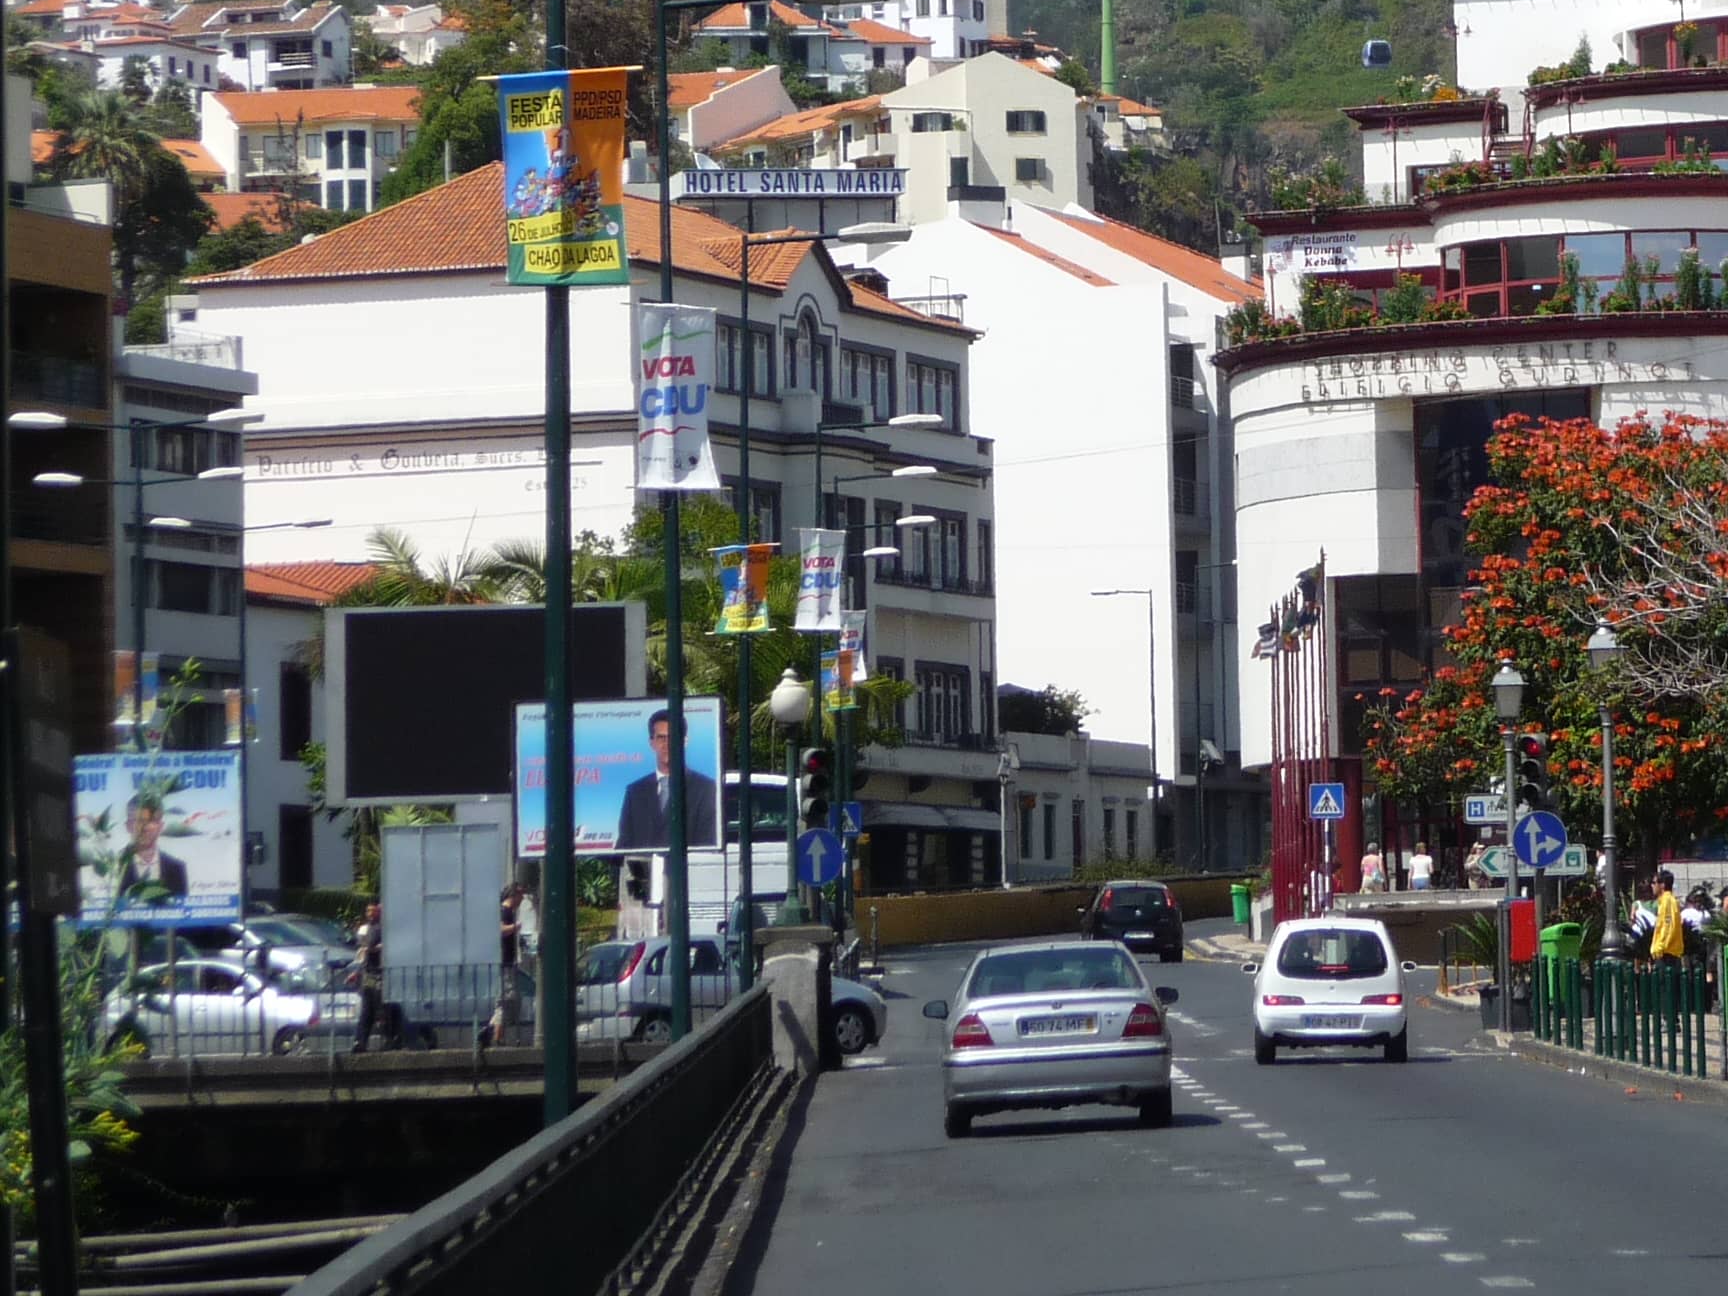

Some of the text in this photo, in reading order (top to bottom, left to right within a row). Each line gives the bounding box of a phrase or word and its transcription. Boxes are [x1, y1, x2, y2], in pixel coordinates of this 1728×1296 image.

[510, 95, 562, 114] FESTA
[573, 89, 622, 106] PPD/PSD
[511, 110, 563, 129] POPULAR
[573, 104, 621, 121] MADEIRA
[686, 171, 902, 193] HOTEL SANTA MARIA
[510, 222, 526, 242] 26
[1291, 232, 1356, 245] Restaurante
[528, 246, 561, 266] CHÃO
[577, 245, 615, 264] LAGOA
[1493, 340, 1618, 367] CENTER
[643, 355, 696, 380] VOTA
[640, 384, 706, 418] CDU
[350, 453, 364, 472] &
[803, 557, 835, 569] VOTA
[801, 572, 841, 589] CDU
